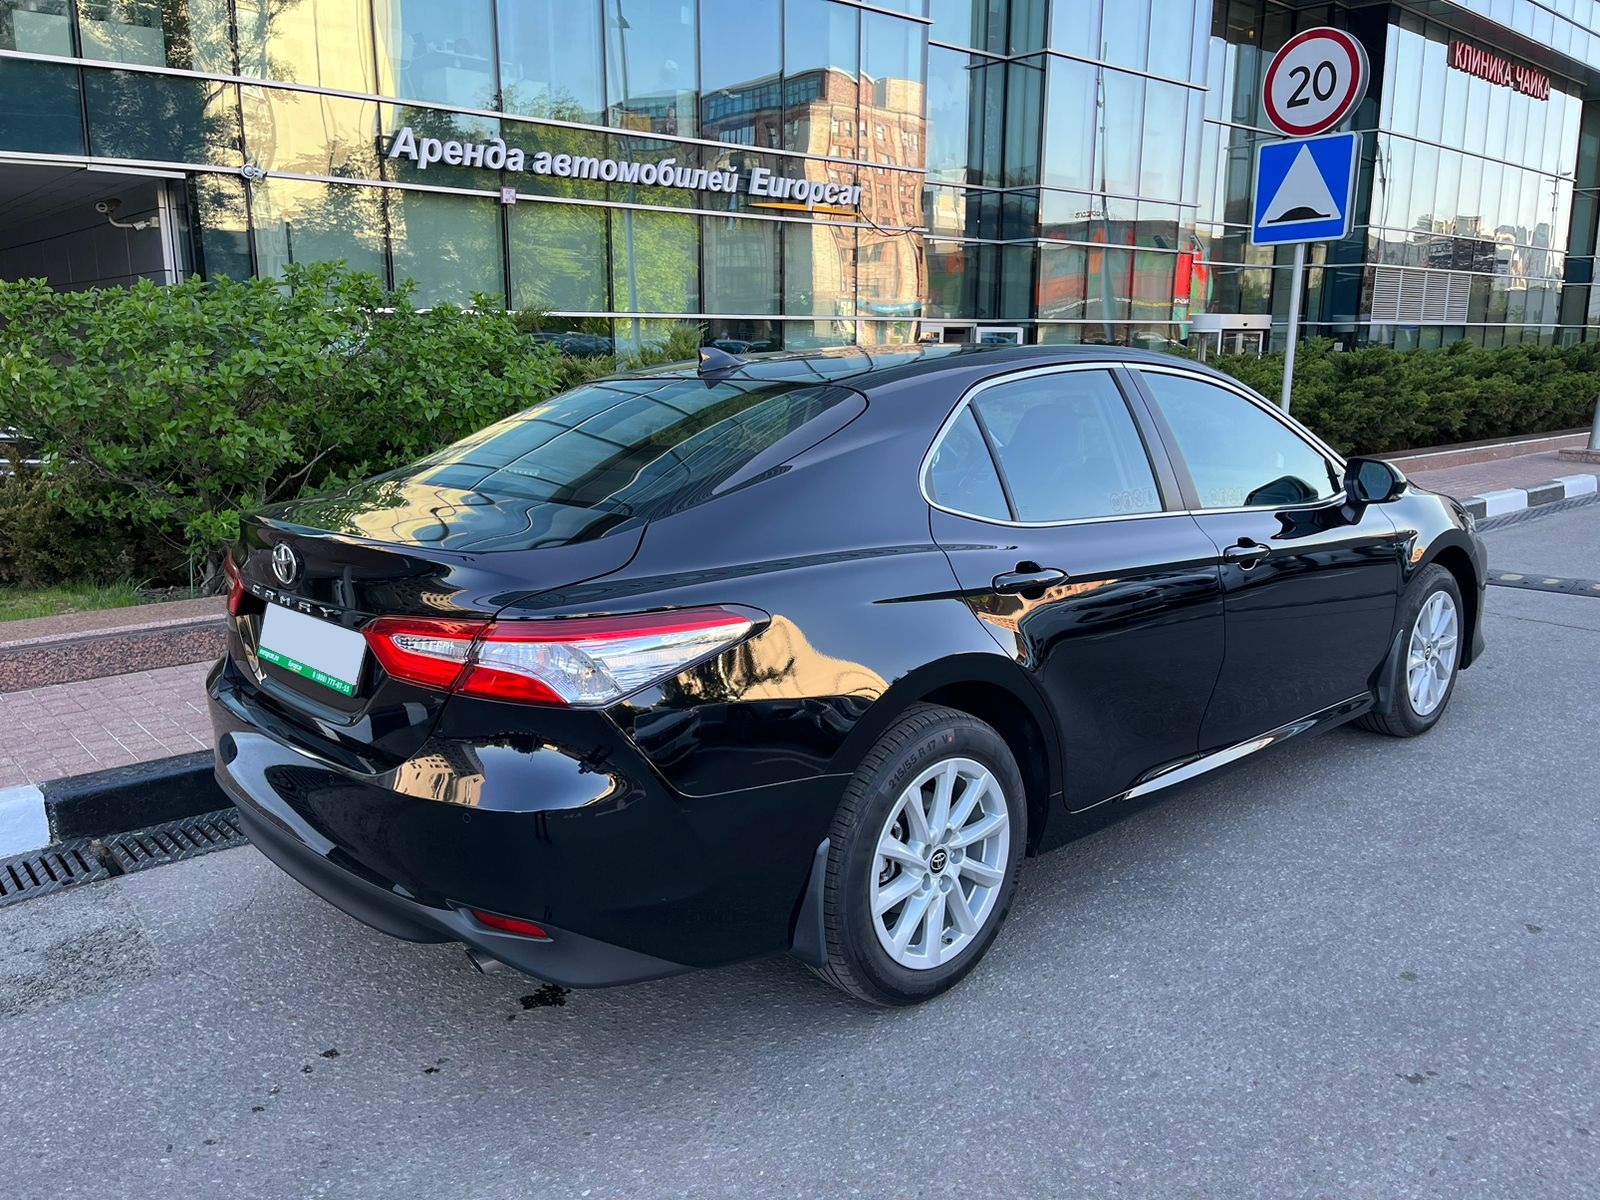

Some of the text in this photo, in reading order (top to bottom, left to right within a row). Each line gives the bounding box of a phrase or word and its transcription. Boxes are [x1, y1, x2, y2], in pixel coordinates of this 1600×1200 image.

[1286, 60, 1338, 109] 20
[1516, 65, 1551, 100] ЧАЙКА
[388, 126, 862, 211] Аренда автомобилей Europcar
[252, 584, 336, 618] CAMRY
[888, 754, 918, 790] 215/55
[918, 747, 927, 758] R
[926, 739, 937, 752] 17
